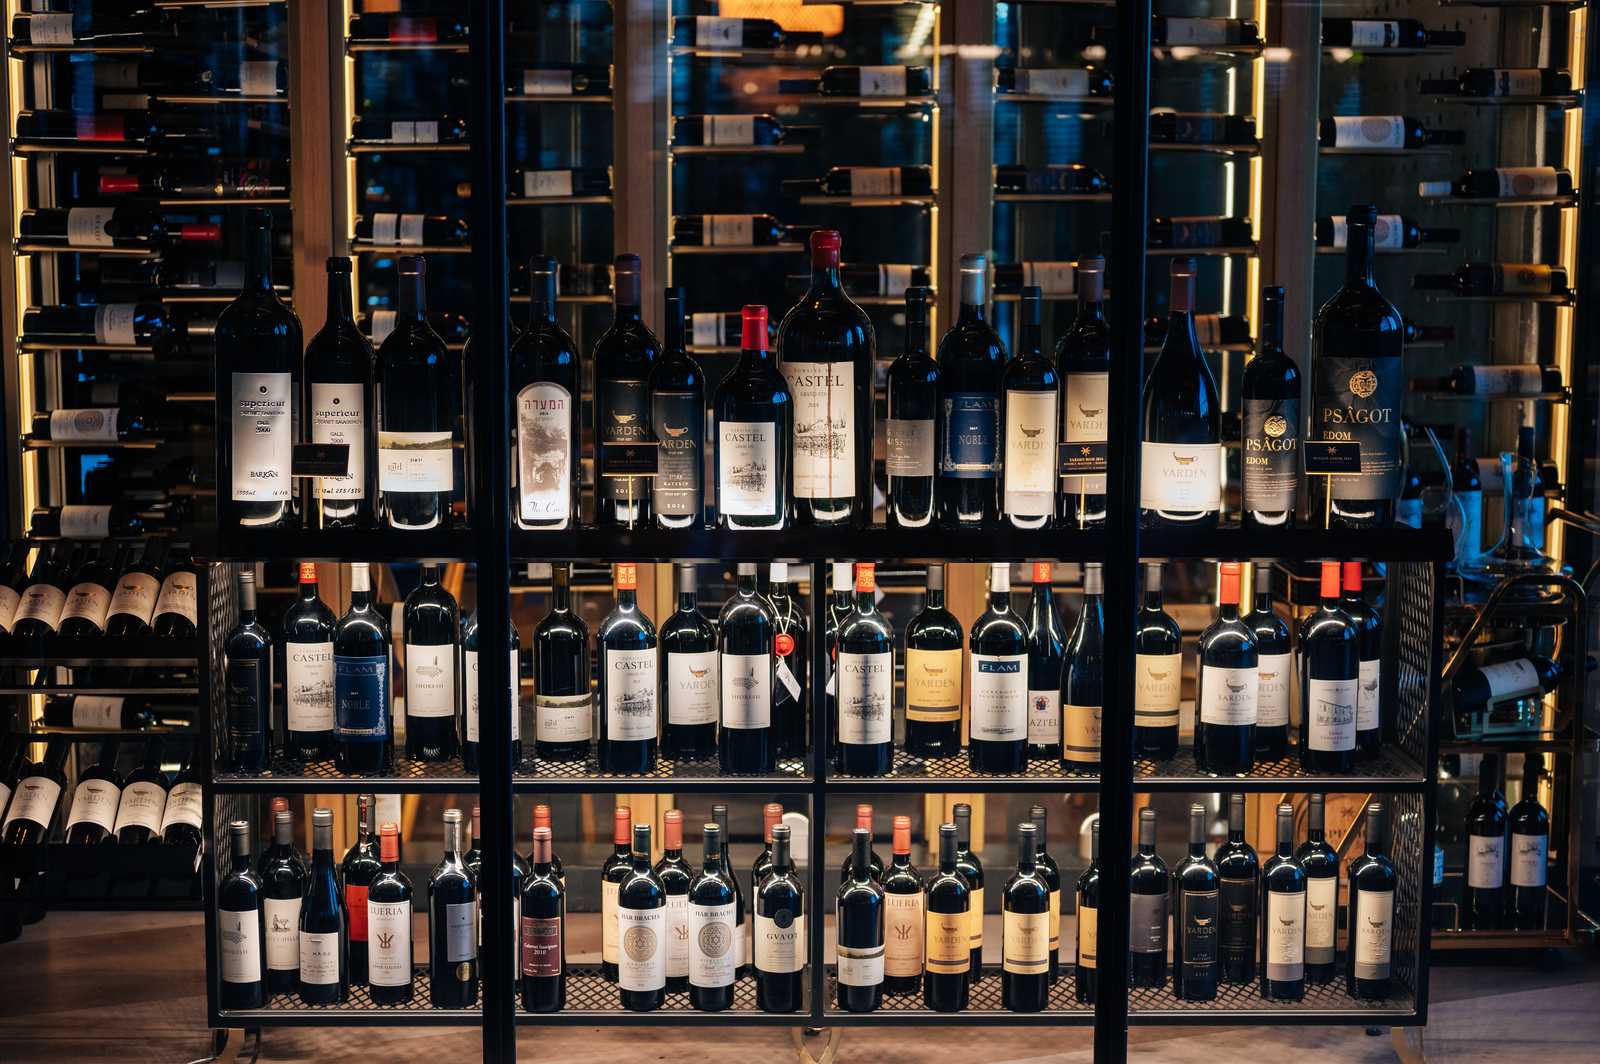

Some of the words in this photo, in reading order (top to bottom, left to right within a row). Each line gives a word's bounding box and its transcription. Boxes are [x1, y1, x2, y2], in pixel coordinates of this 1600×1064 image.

[1323, 405, 1392, 424] PSÂGOT
[725, 433, 767, 442] CASTEL
[1246, 456, 1268, 465] EDOM
[293, 653, 333, 662] CASTEL
[615, 661, 655, 671] CASTEL
[844, 664, 886, 673] CASTEL
[981, 663, 1018, 672] FLAM
[370, 905, 404, 915] LUERIA
